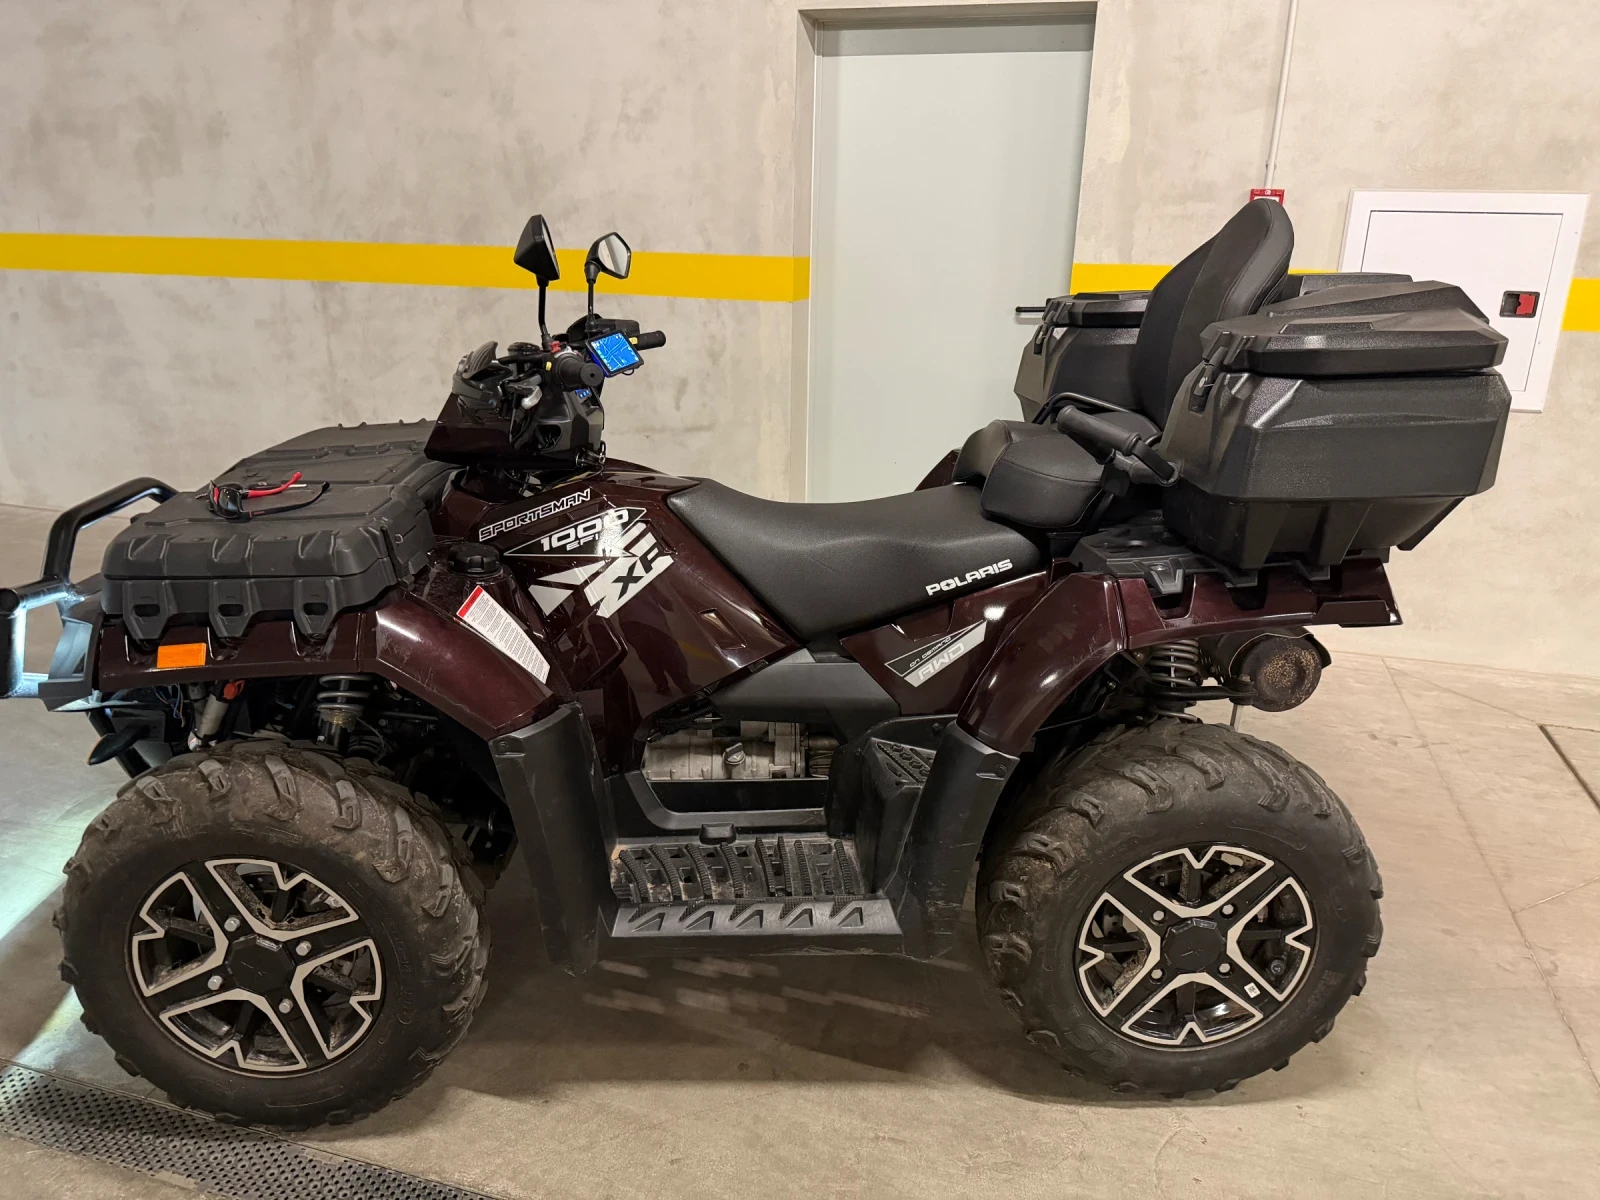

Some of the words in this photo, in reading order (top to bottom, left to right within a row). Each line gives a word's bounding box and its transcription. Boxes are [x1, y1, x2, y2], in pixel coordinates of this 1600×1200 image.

[479, 488, 591, 542] SPORTSMAN
[541, 509, 629, 552] 1000
[566, 533, 599, 551] EFI
[611, 542, 664, 601] XP
[925, 558, 1013, 595] POLARIS
[918, 642, 965, 681] AWD
